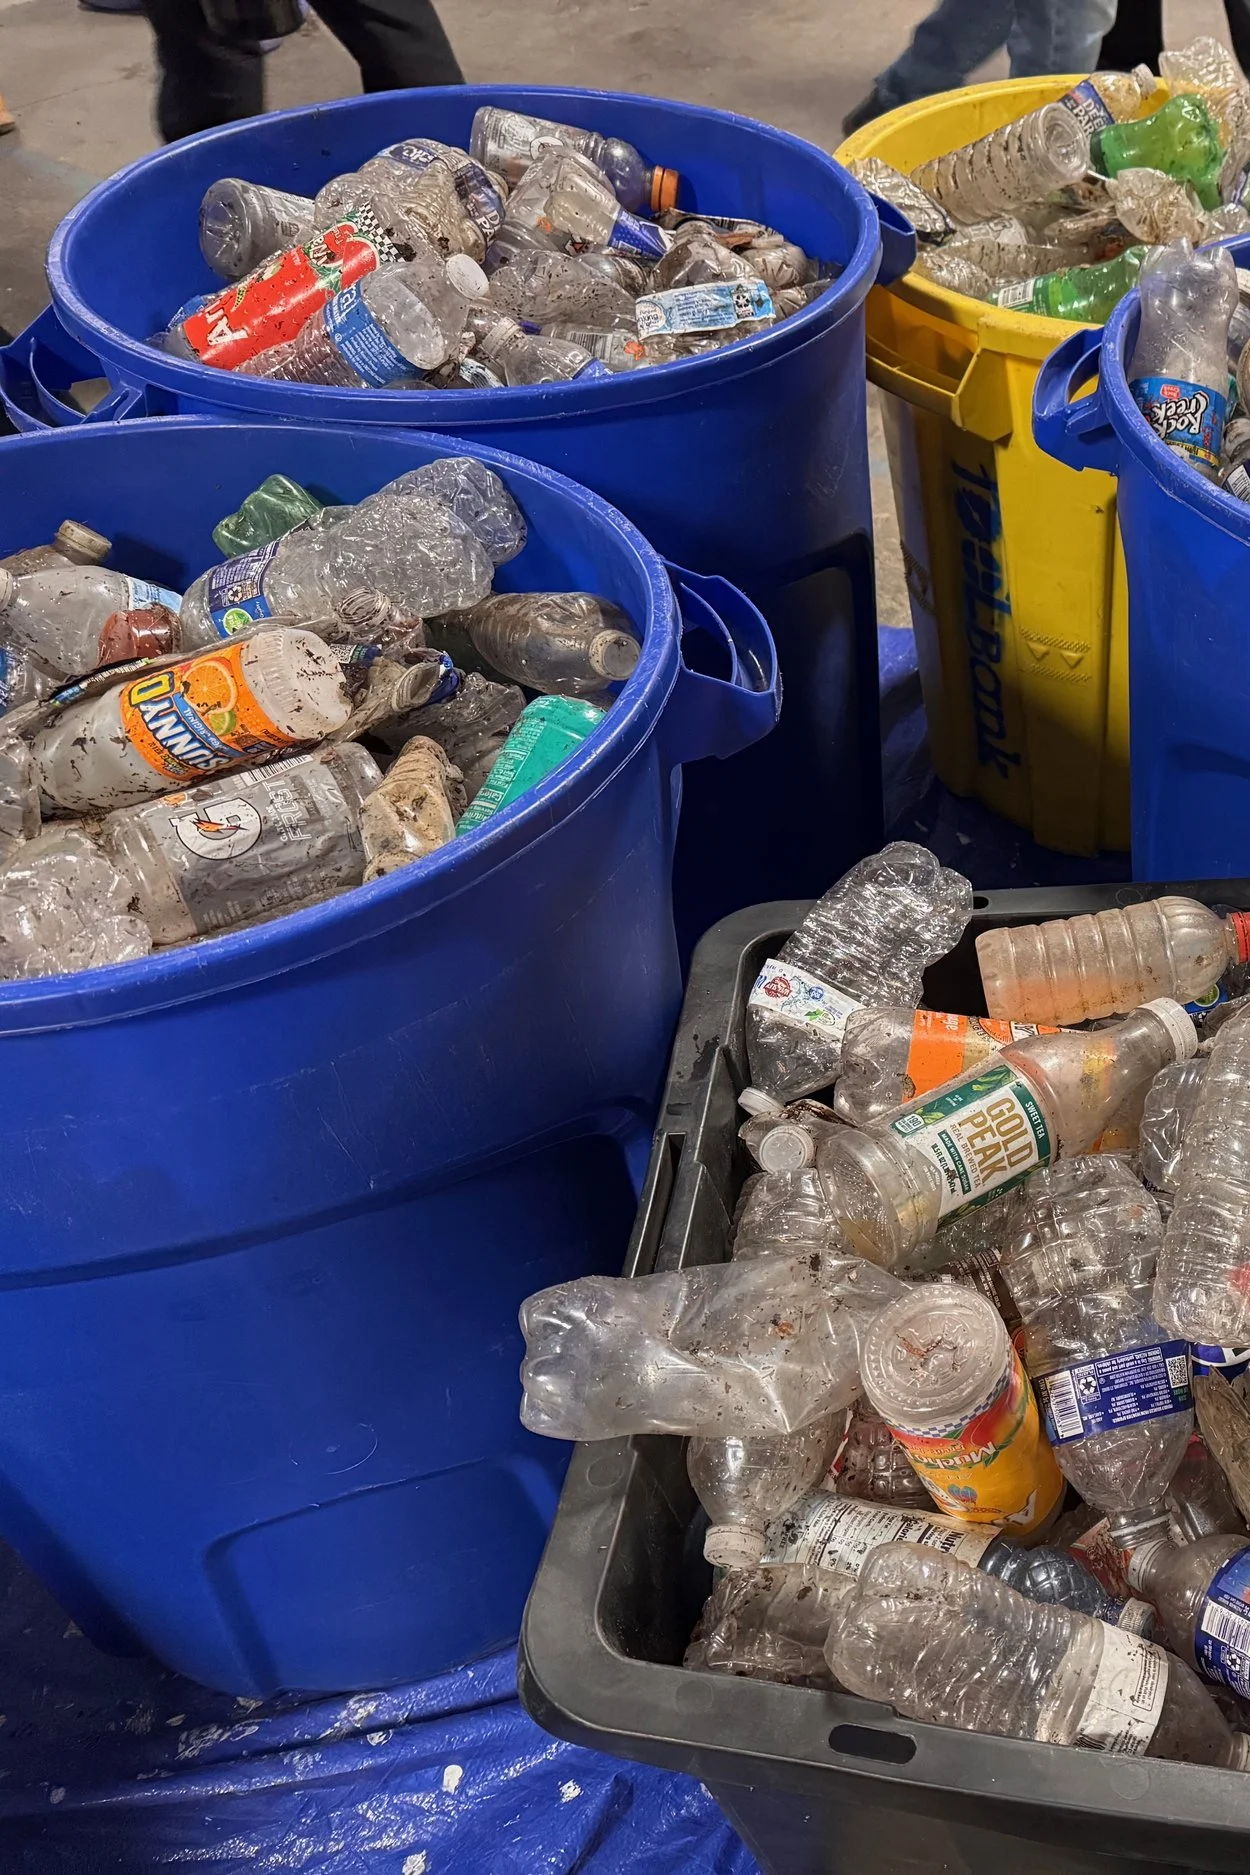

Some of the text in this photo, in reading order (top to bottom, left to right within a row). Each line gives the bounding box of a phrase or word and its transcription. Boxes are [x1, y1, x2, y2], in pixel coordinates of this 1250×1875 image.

[1070, 106, 1099, 134] PAR
[1152, 390, 1209, 423] Creek
[1153, 413, 1201, 438] Rock
[907, 1114, 919, 1128] 190
[986, 1096, 1036, 1169] GOLD
[1024, 1101, 1047, 1139] SWEET TEA
[941, 1132, 952, 1148] MADE
[949, 1147, 959, 1161] WITH
[954, 1161, 966, 1175] CANE
[950, 1123, 983, 1188] REAL BREWED TEA
[959, 1111, 998, 1185] PEAK
[915, 1440, 997, 1471] Mucho
